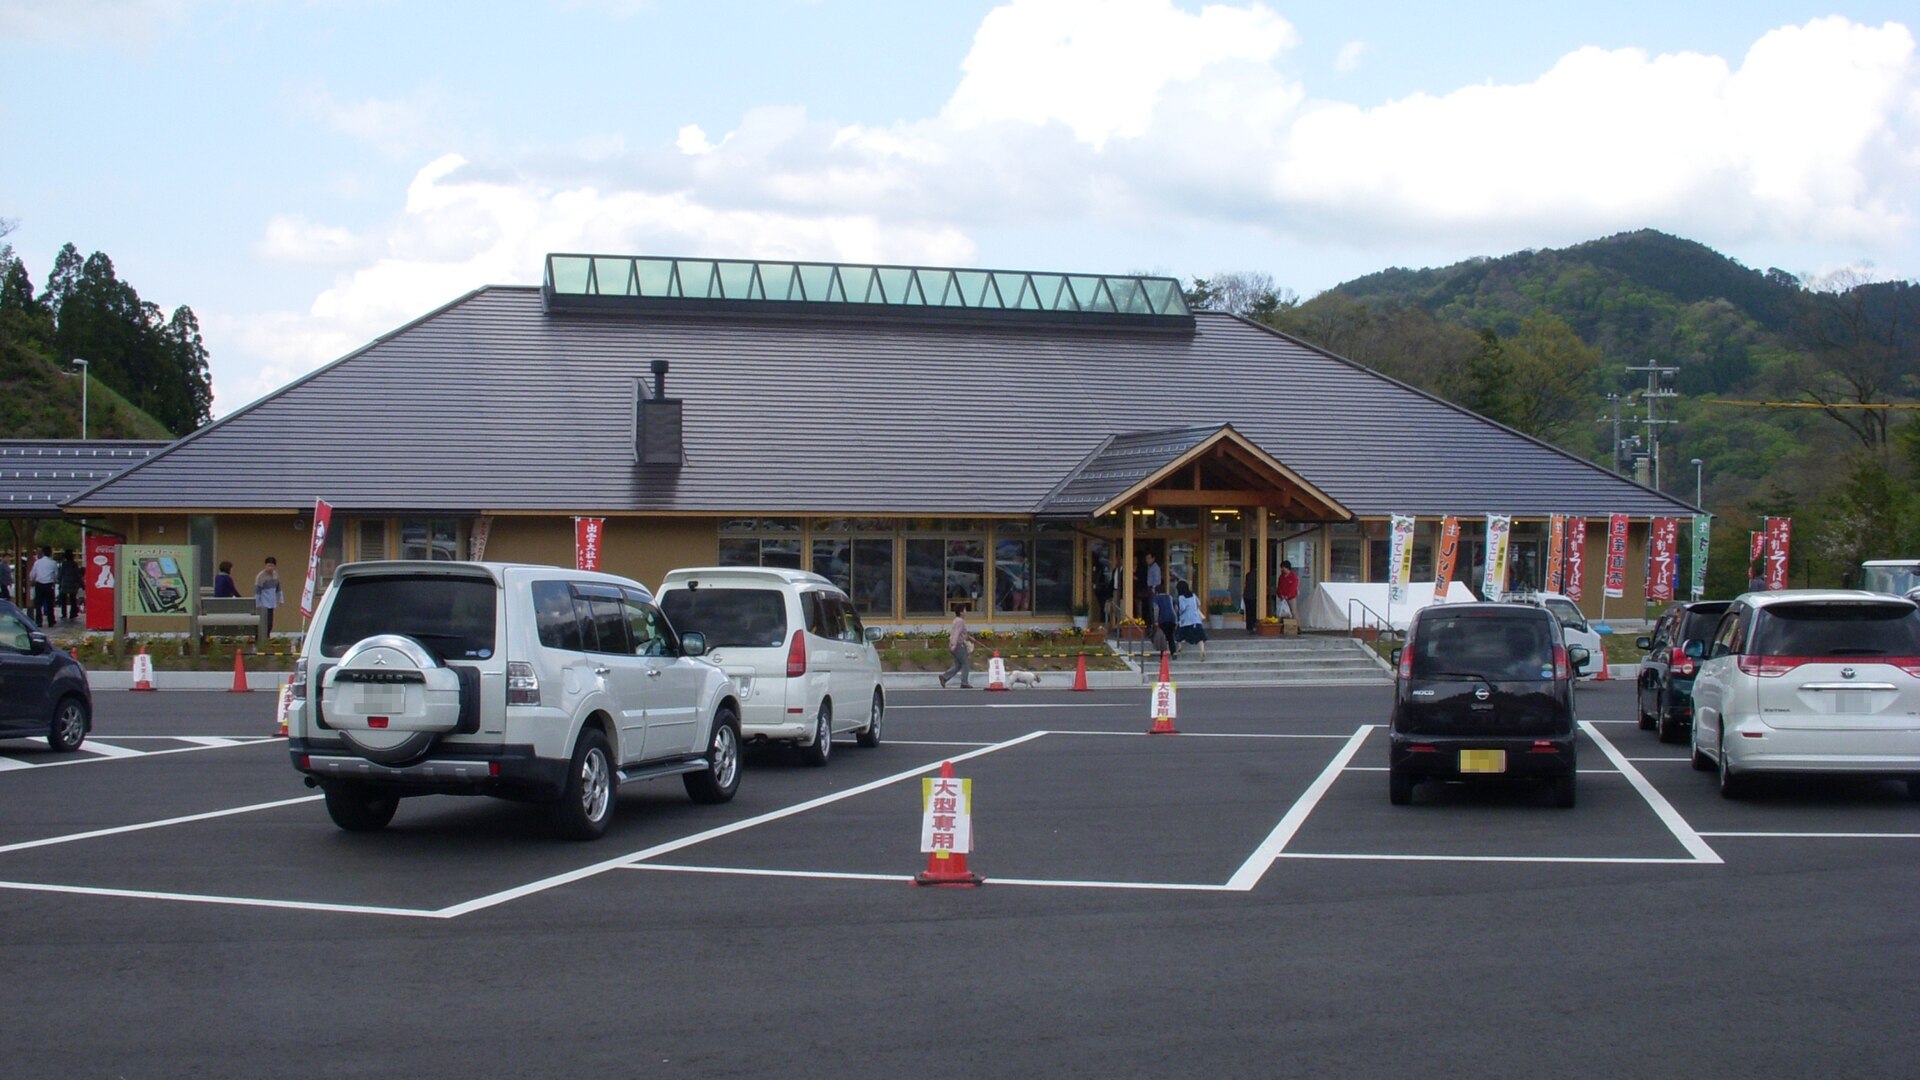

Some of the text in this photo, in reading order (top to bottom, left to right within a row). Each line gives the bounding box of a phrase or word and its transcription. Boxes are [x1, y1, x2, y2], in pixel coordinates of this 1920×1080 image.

[1157, 684, 1169, 716] 大型専用
[931, 780, 957, 849] 大型専用
